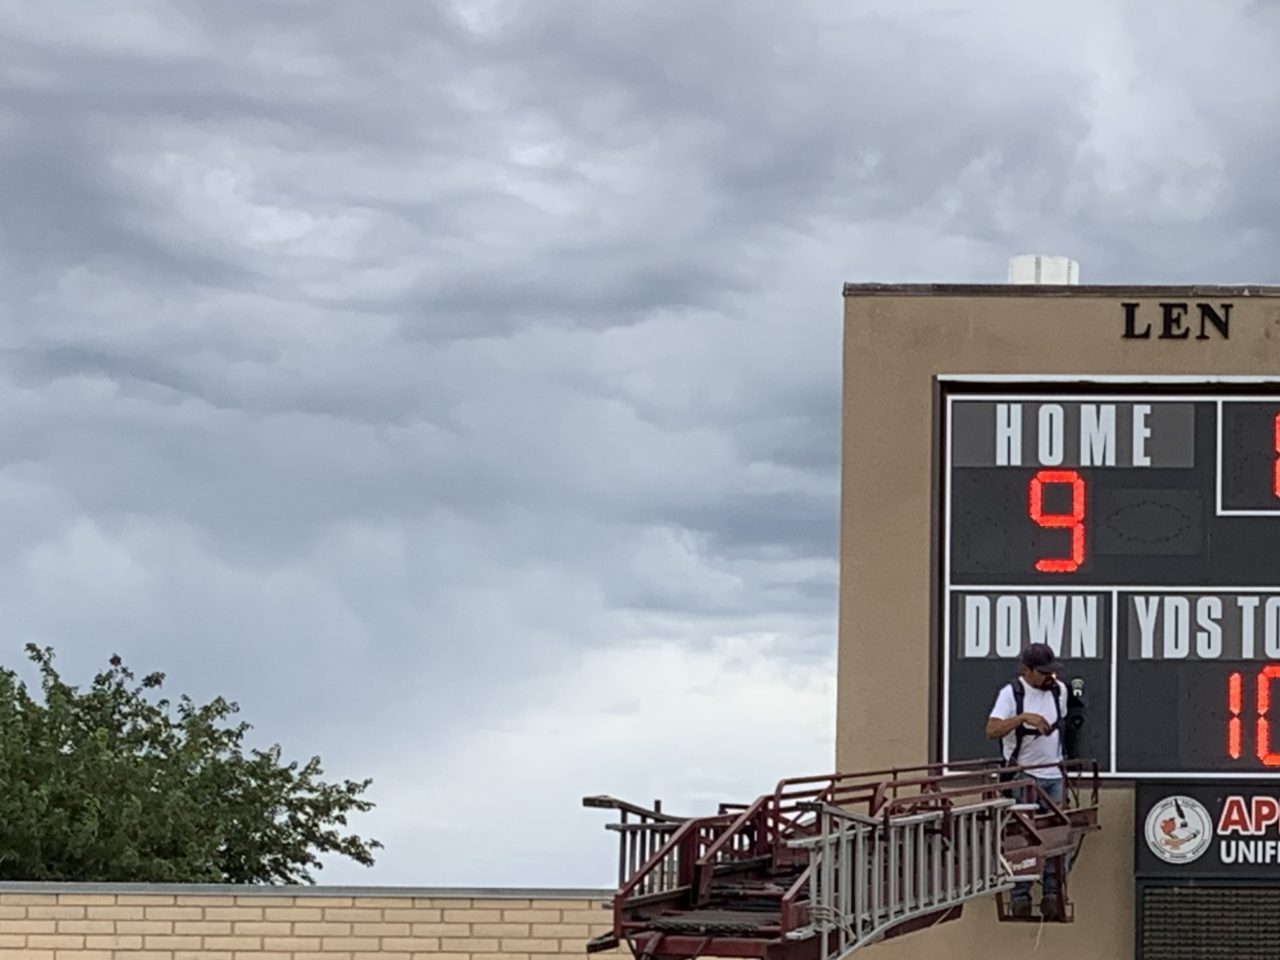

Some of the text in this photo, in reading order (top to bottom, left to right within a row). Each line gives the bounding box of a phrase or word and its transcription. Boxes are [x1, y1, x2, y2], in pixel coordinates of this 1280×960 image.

[1121, 302, 1234, 340] LEN
[996, 404, 1152, 466] HOME
[1029, 470, 1086, 573] 9
[964, 595, 1098, 658] DOWN
[1134, 596, 1222, 659] YDS
